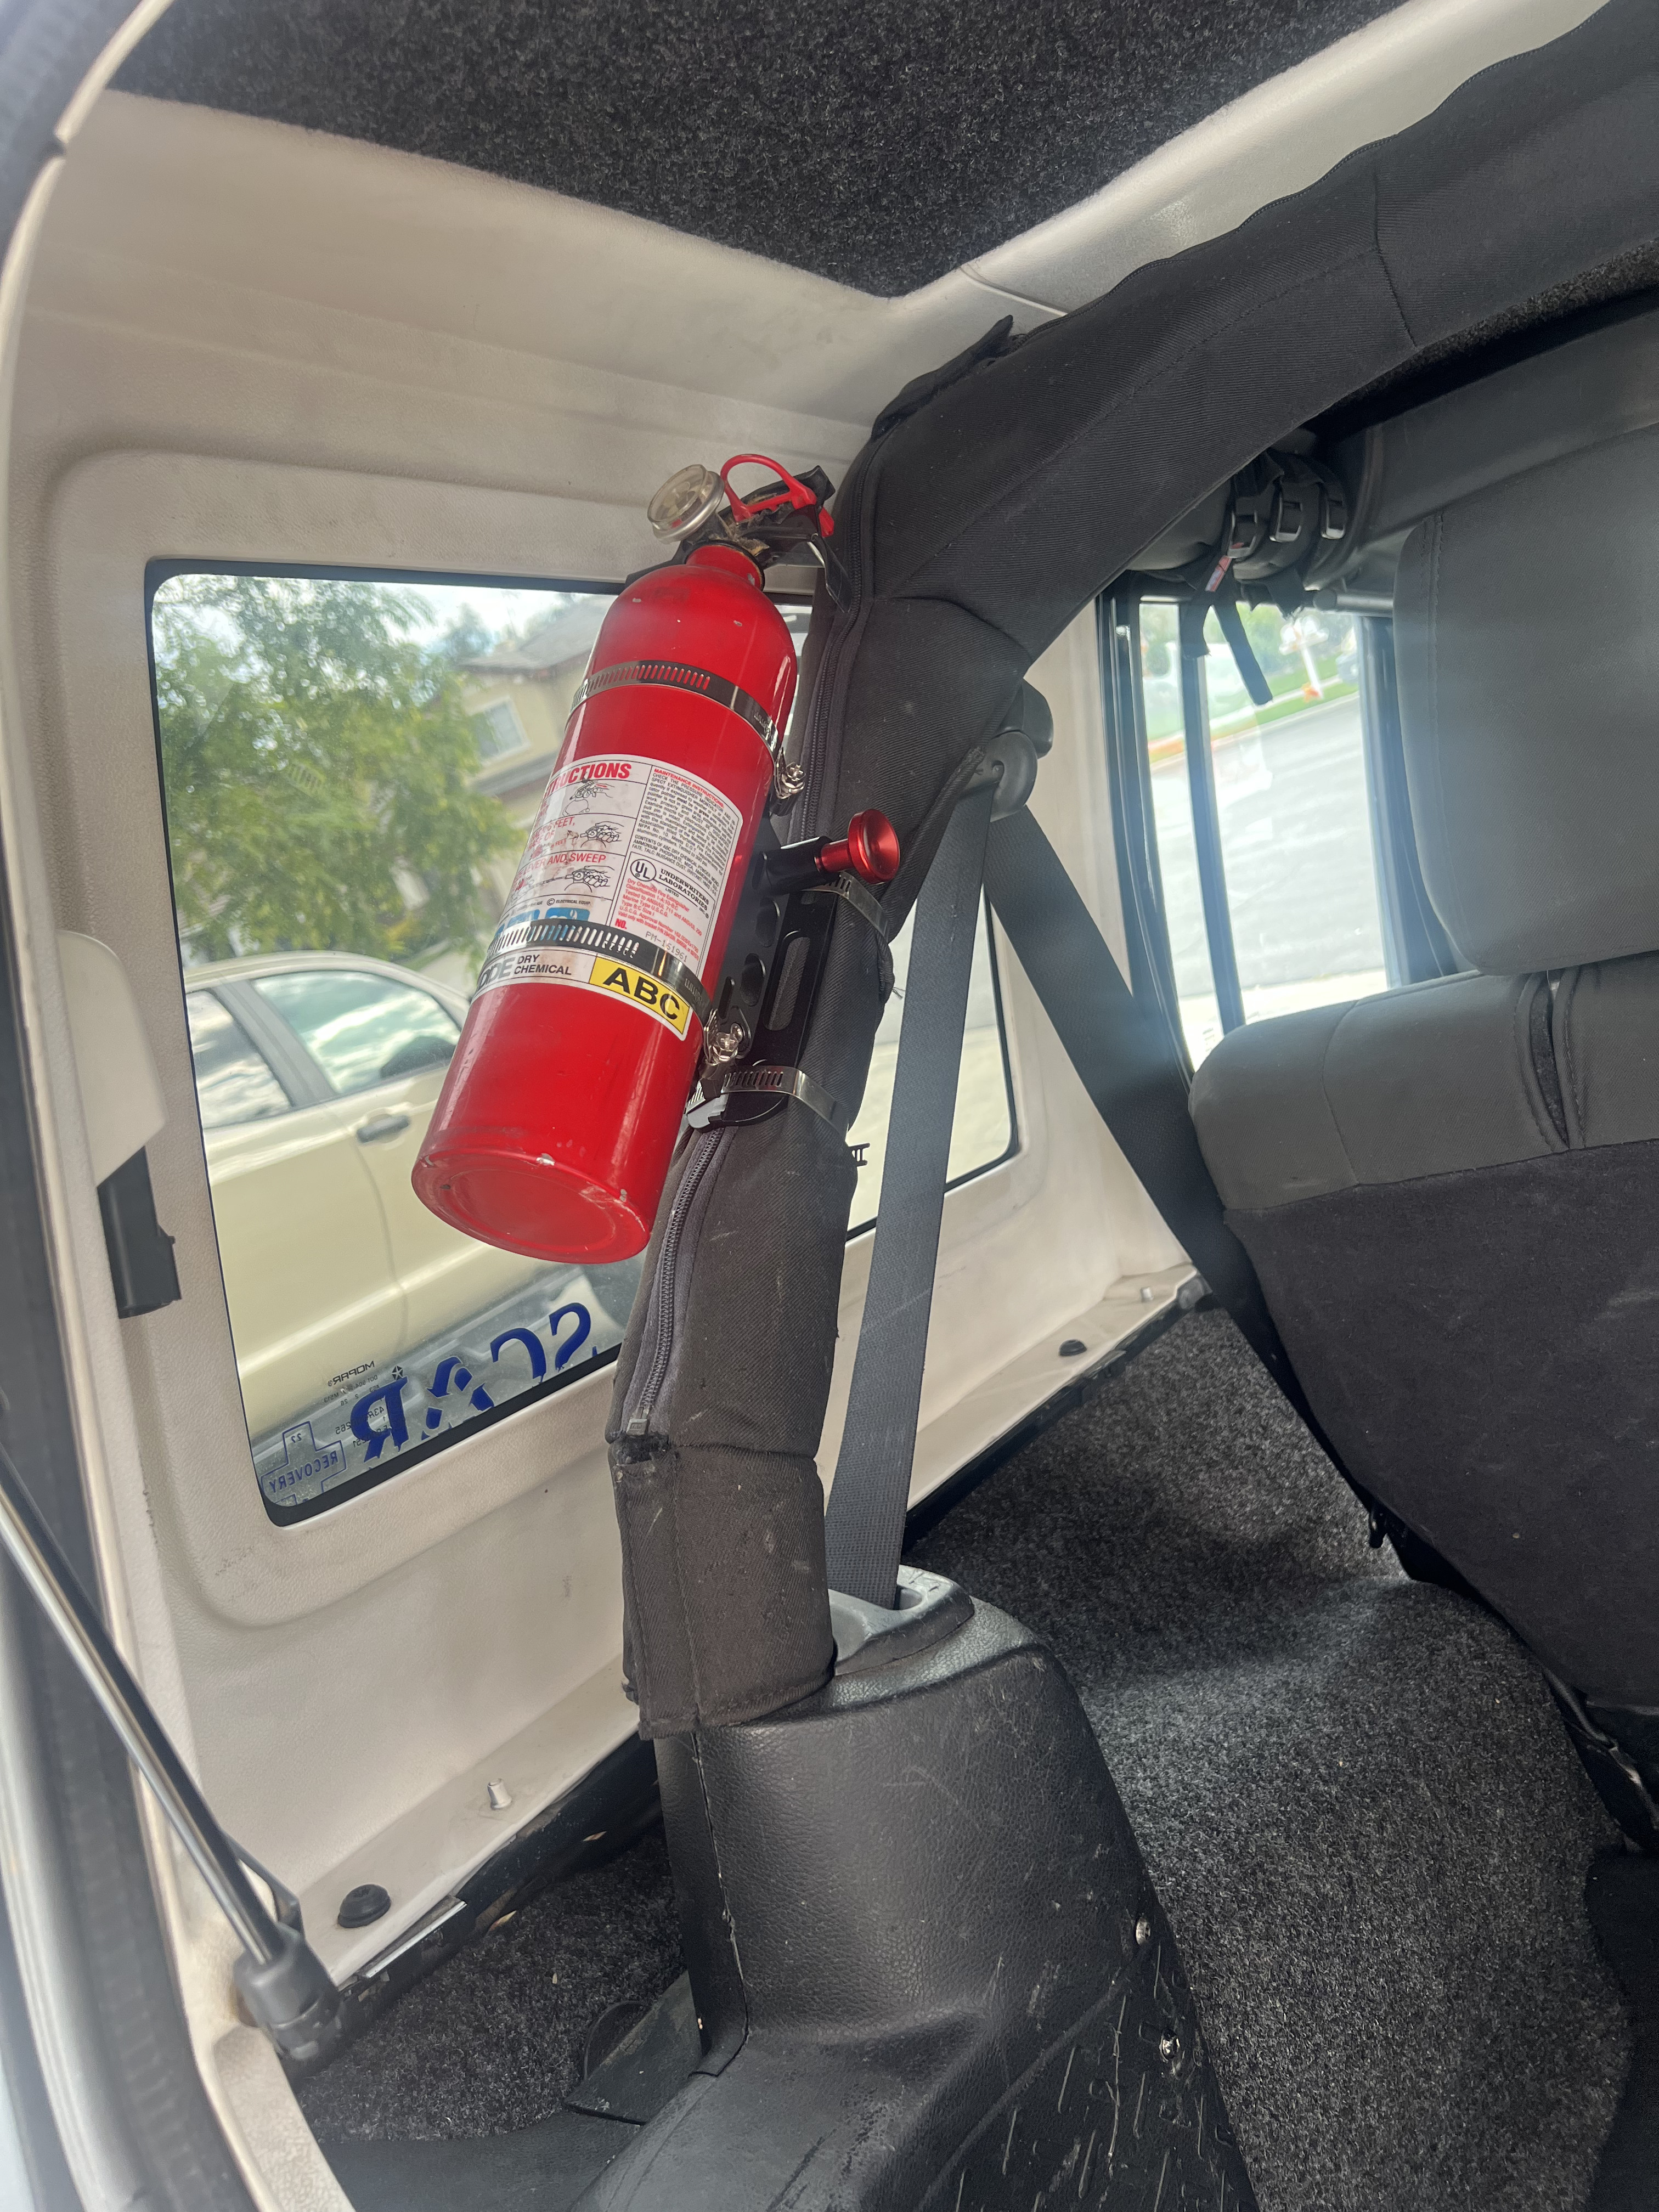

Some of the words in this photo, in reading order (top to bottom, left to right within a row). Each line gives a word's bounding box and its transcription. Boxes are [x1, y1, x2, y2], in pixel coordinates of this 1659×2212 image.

[654, 768, 691, 786] MAINTENANCE
[652, 772, 668, 781] CHECK
[681, 782, 703, 797] PRESSURE
[704, 795, 723, 812] INDICATOR
[667, 782, 698, 799] EXTINGUISHER
[699, 798, 716, 813] MONTHLY
[670, 789, 687, 799] exposed
[660, 800, 678, 810] properly
[692, 814, 703, 824] MUST
[635, 834, 656, 844] CONTENTS
[547, 854, 567, 865] AND
[571, 853, 606, 864] SWEEP
[634, 861, 652, 879] UL
[625, 889, 640, 898] Tested
[658, 874, 708, 911] LABORATORIES
[660, 868, 709, 905] UNDERWRITERS
[665, 887, 679, 898] LISTED
[622, 894, 639, 904] Marine
[517, 955, 540, 964] DRY
[514, 964, 572, 975] CHEMICAL
[603, 968, 680, 1020] ABC
